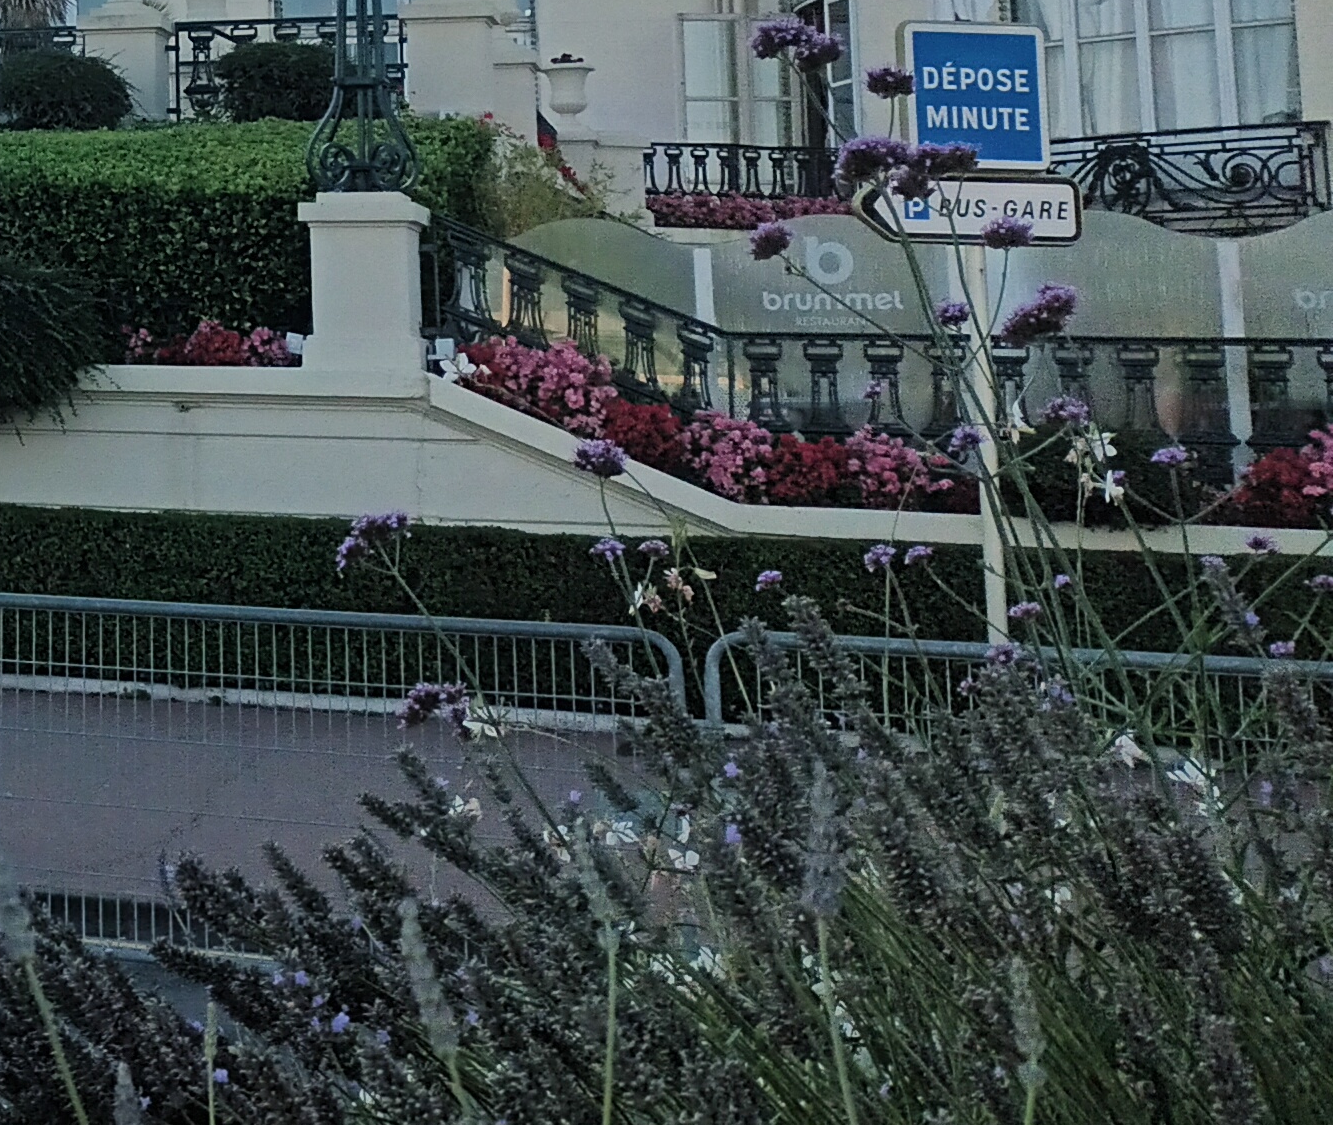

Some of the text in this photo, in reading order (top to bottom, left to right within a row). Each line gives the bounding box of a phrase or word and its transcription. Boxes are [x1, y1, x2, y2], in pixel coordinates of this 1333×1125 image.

[921, 61, 1031, 93] DÉPOSE
[926, 105, 1031, 131] MINUTE
[908, 197, 925, 218] P
[762, 290, 904, 311] brummel
